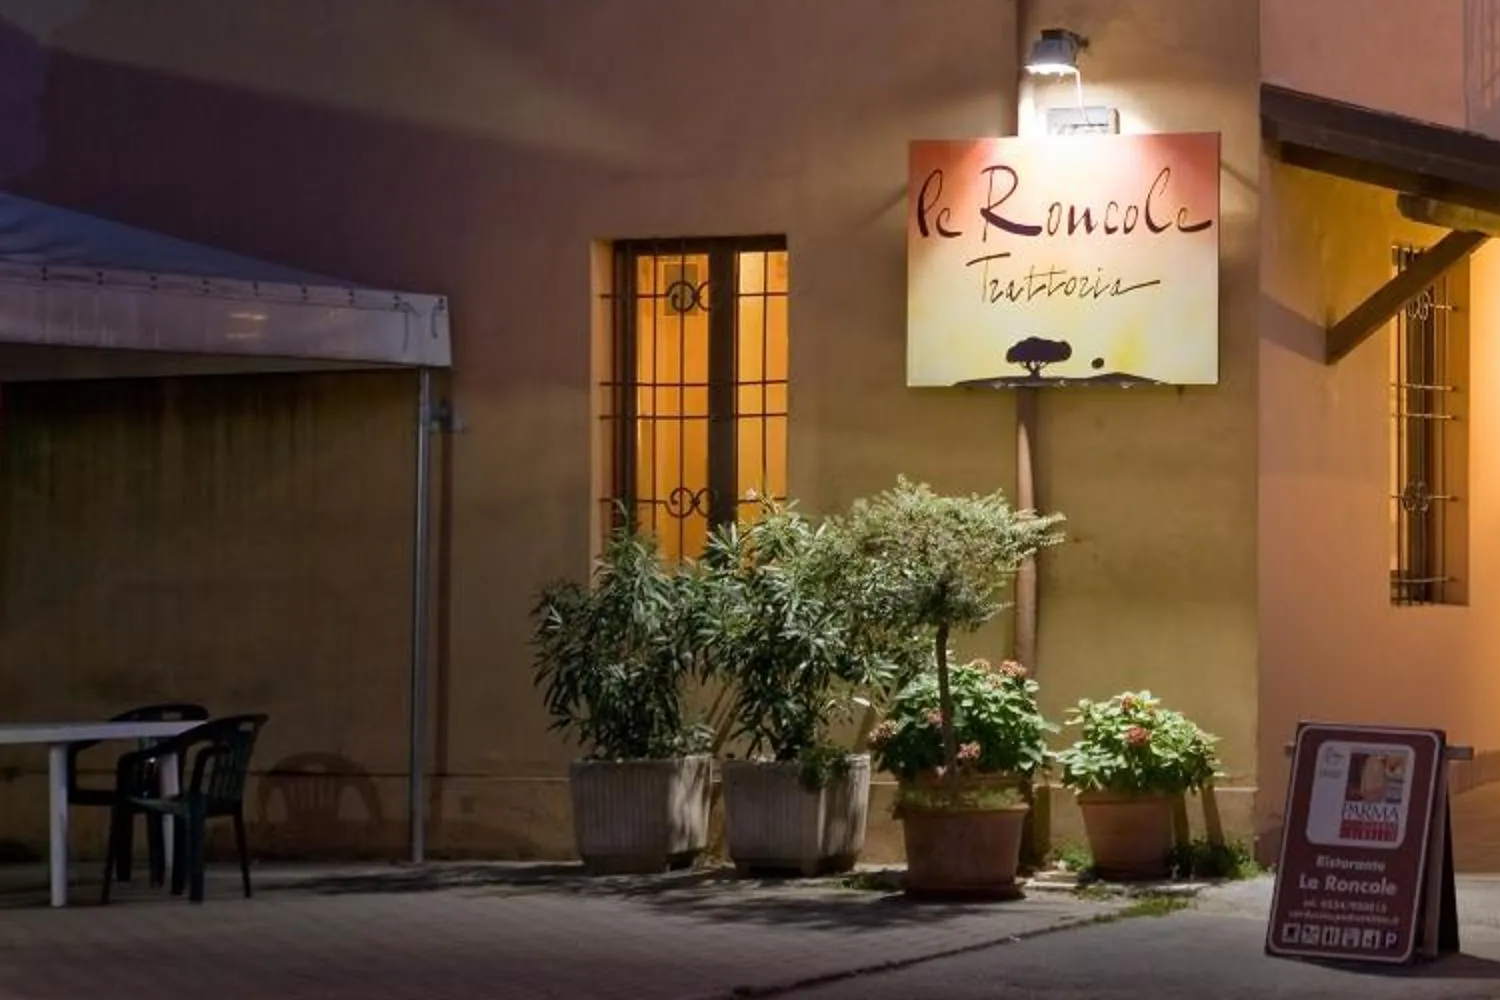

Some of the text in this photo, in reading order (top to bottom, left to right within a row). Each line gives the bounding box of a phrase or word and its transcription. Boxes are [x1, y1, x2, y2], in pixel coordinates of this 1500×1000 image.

[980, 164, 1213, 243] Roncole
[966, 251, 1162, 304] Trattoria
[1299, 873, 1398, 896] Le Roncole
[1385, 932, 1397, 948] P
